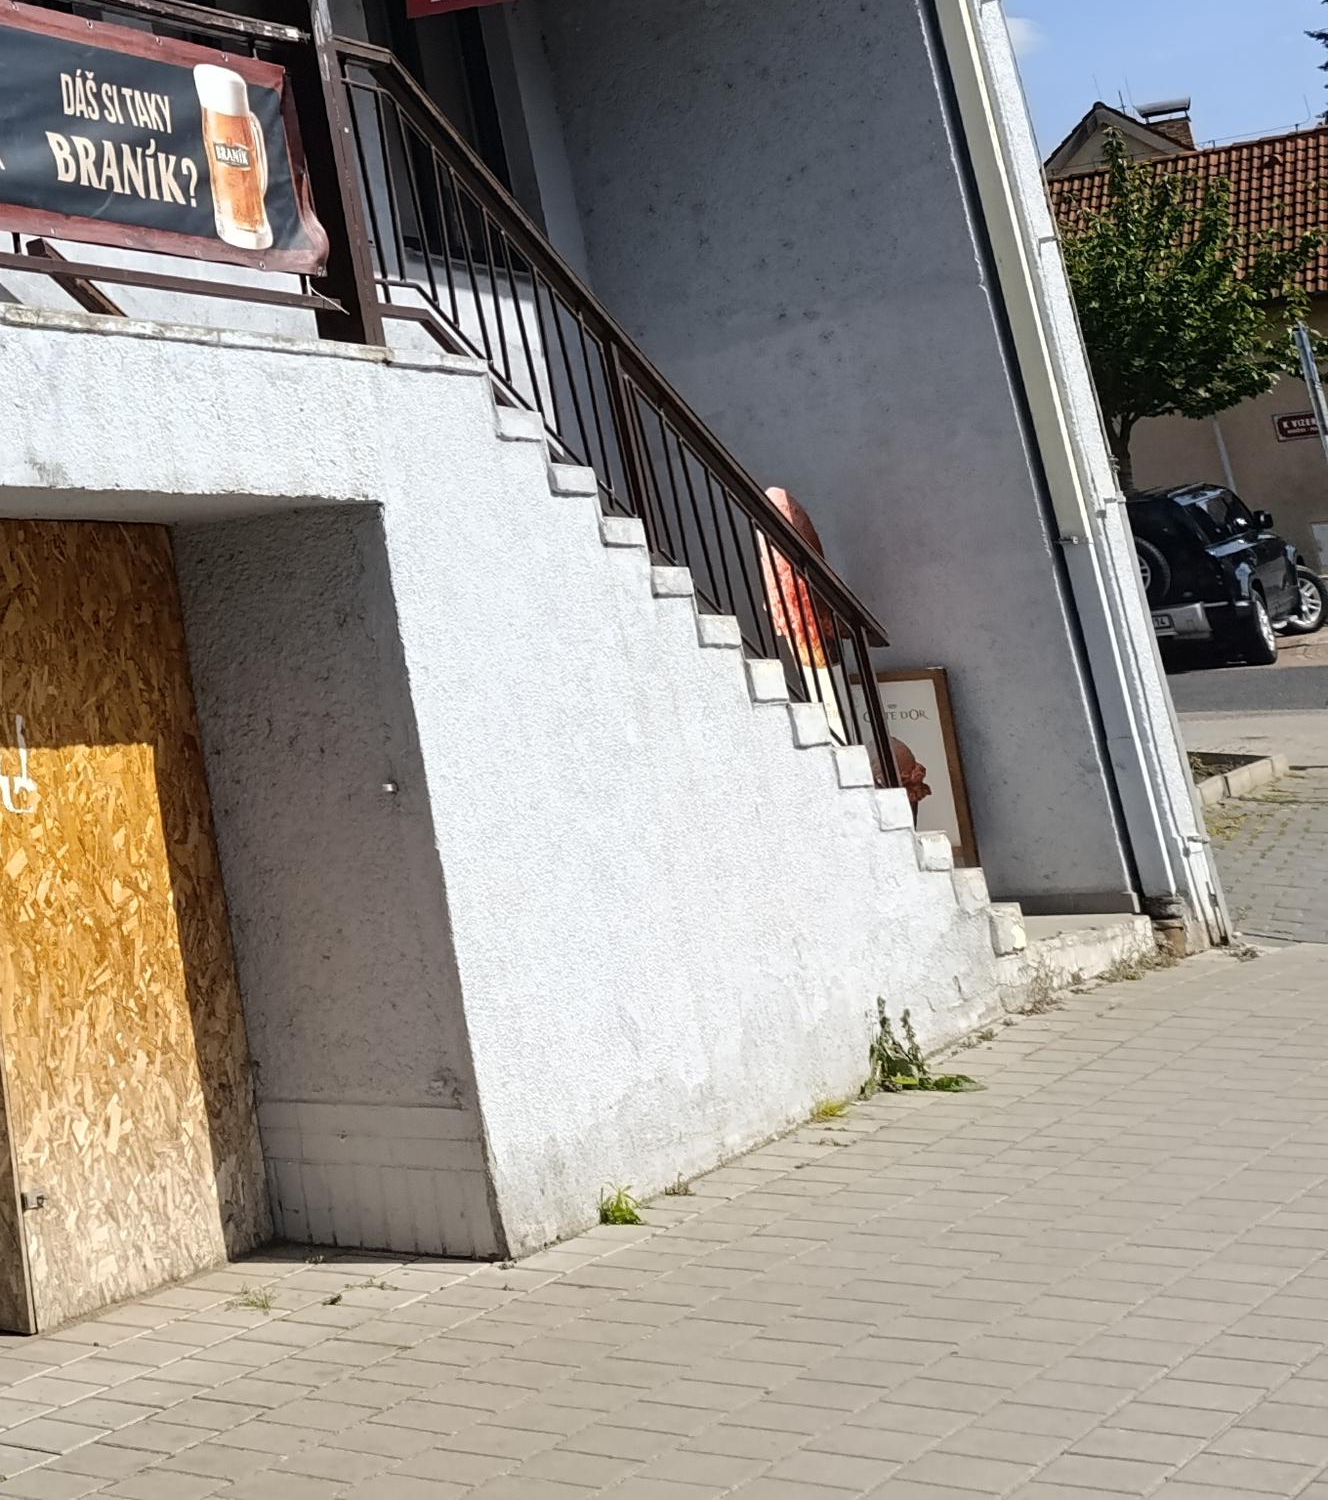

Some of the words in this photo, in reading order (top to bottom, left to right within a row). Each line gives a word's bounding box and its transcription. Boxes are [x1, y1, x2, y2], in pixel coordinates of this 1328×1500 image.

[59, 68, 100, 121] DÁŠ
[101, 81, 125, 125] SI
[120, 86, 173, 134] TAKY
[44, 130, 199, 208] BRANÍK?
